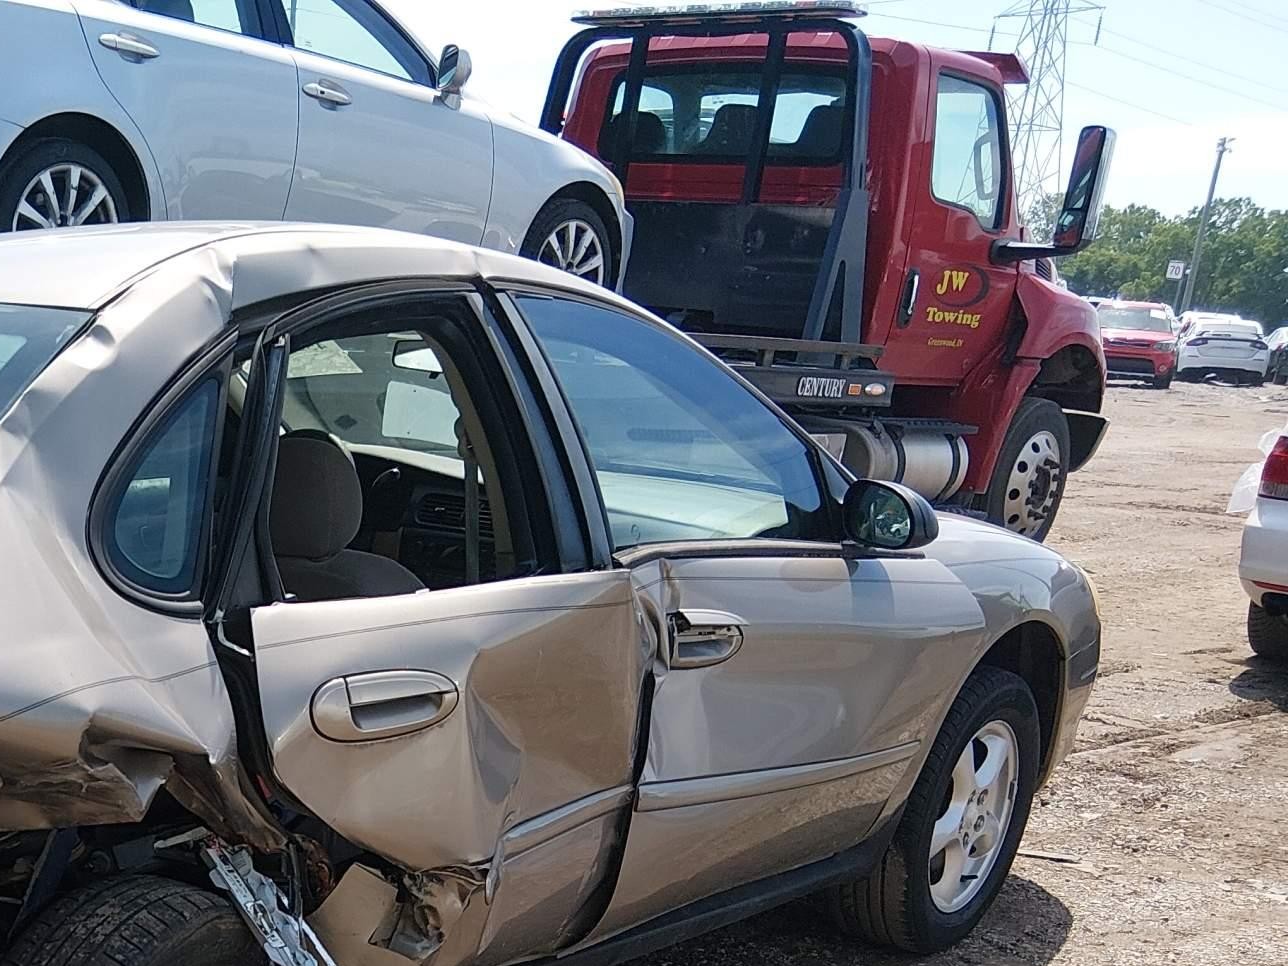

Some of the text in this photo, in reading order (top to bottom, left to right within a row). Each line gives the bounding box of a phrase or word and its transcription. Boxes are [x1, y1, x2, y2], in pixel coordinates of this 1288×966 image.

[1170, 265, 1180, 276] 70
[936, 270, 970, 294] JW
[926, 306, 982, 329] Towing
[797, 376, 847, 398] CENTURY
